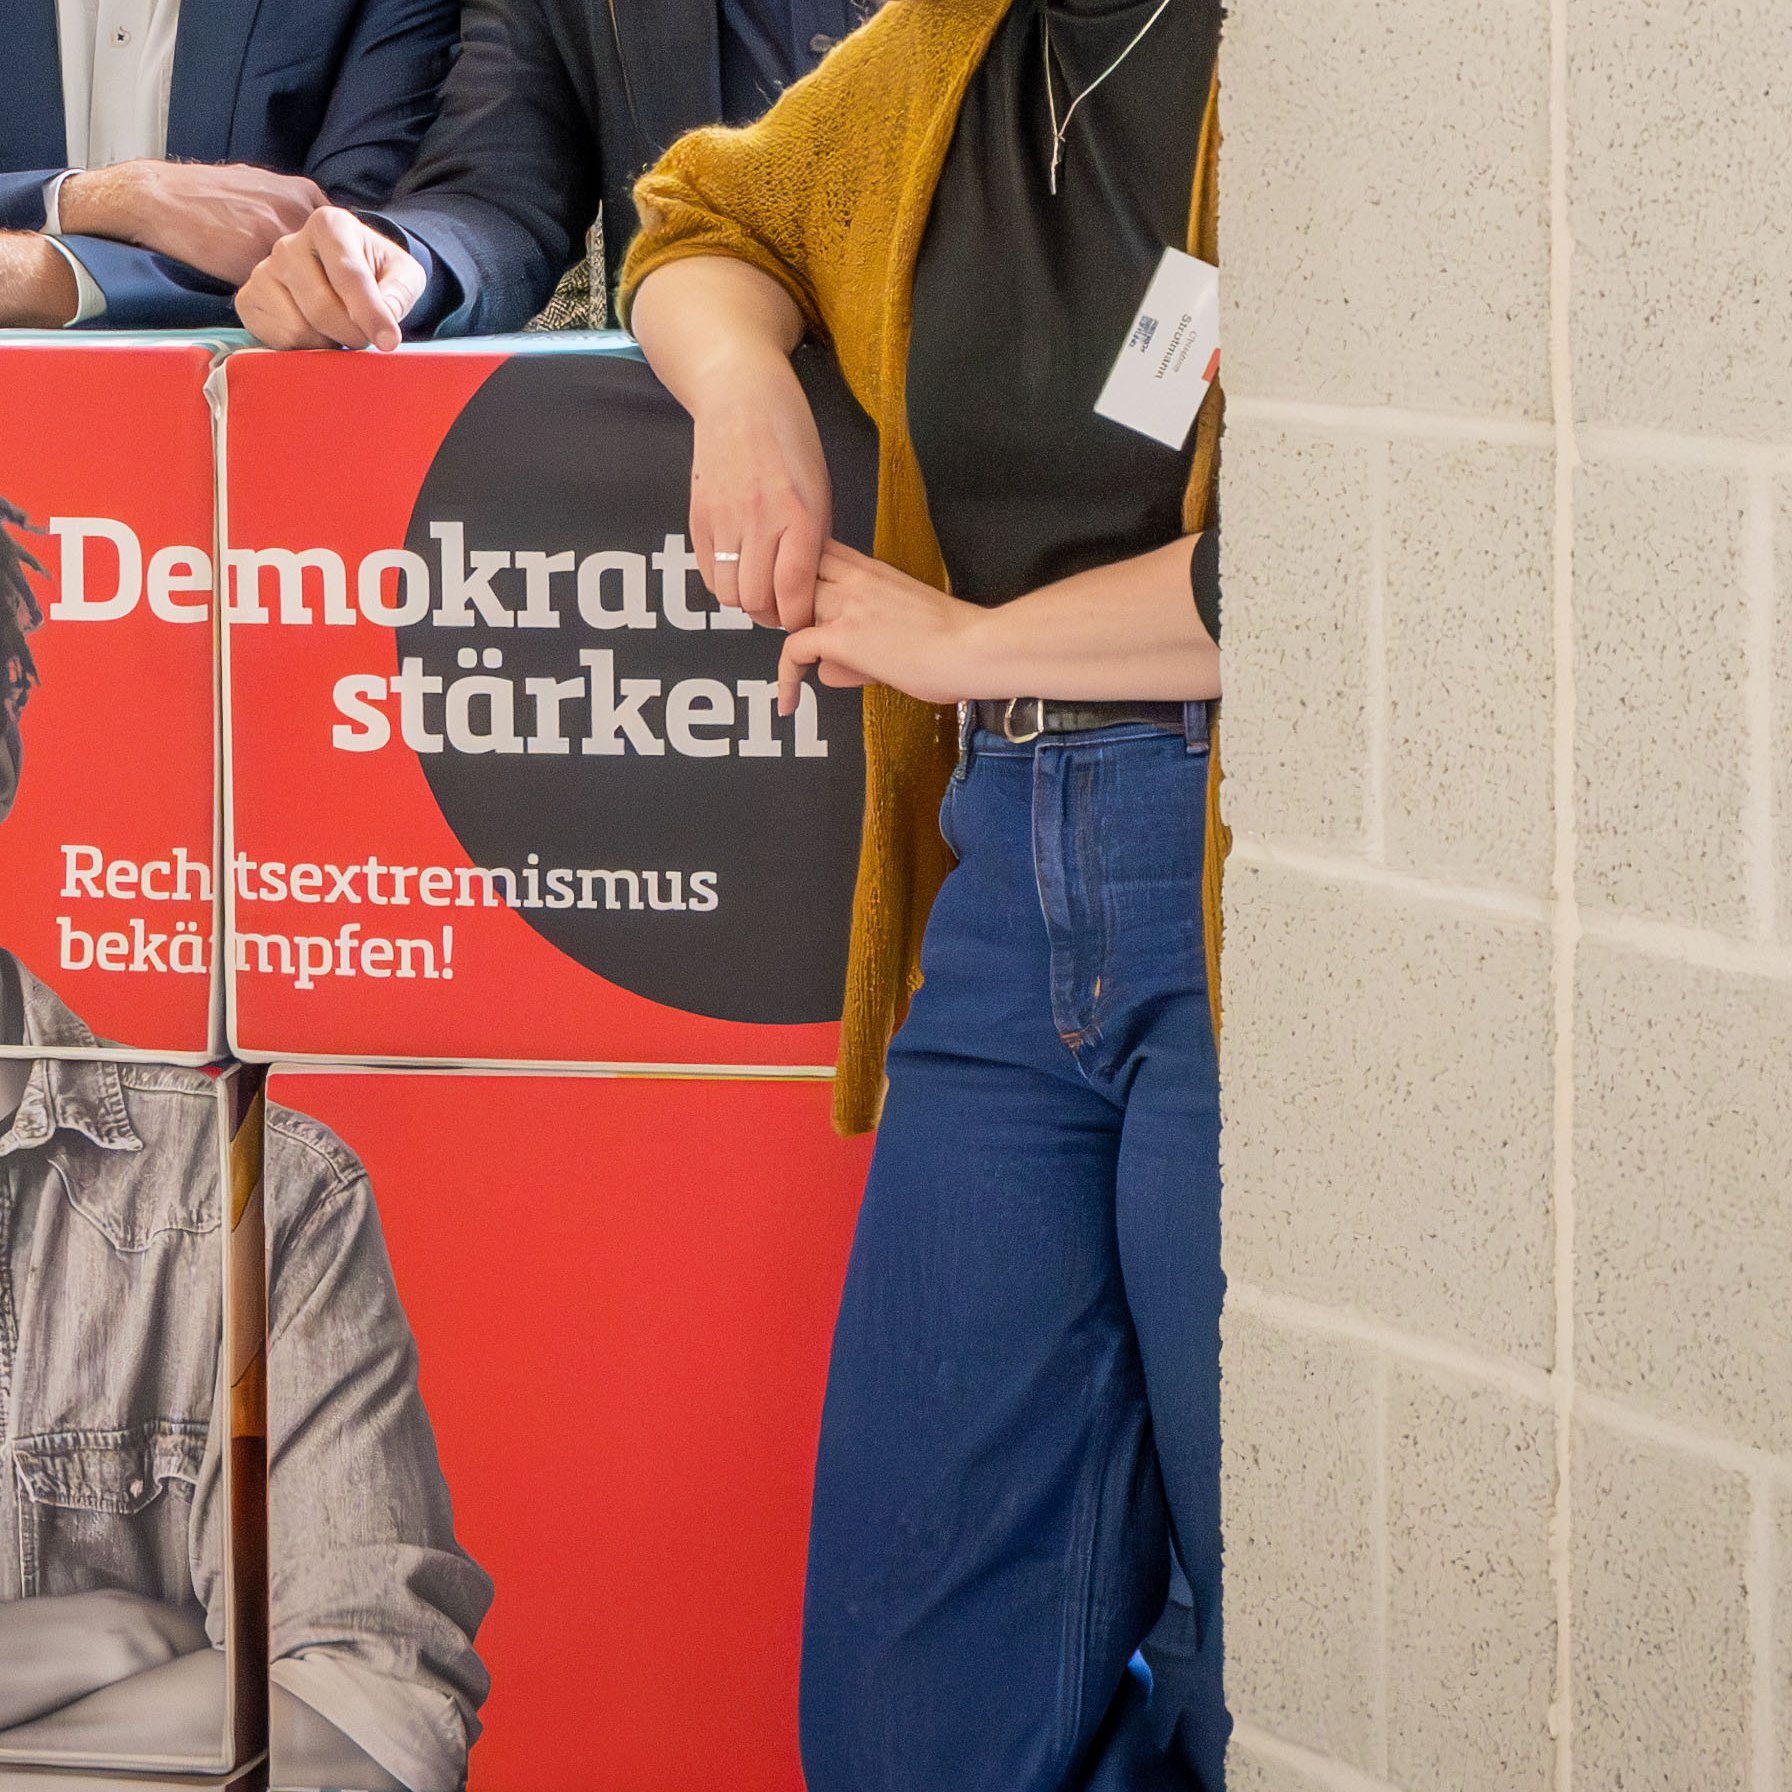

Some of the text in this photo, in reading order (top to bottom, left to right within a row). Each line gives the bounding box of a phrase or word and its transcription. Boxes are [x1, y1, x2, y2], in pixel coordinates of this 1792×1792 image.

[49, 517, 789, 631] Demokrat
[332, 648, 828, 758] stärken
[60, 844, 719, 912] Rechtsextremismus
[56, 916, 454, 989] bekämpfen!
